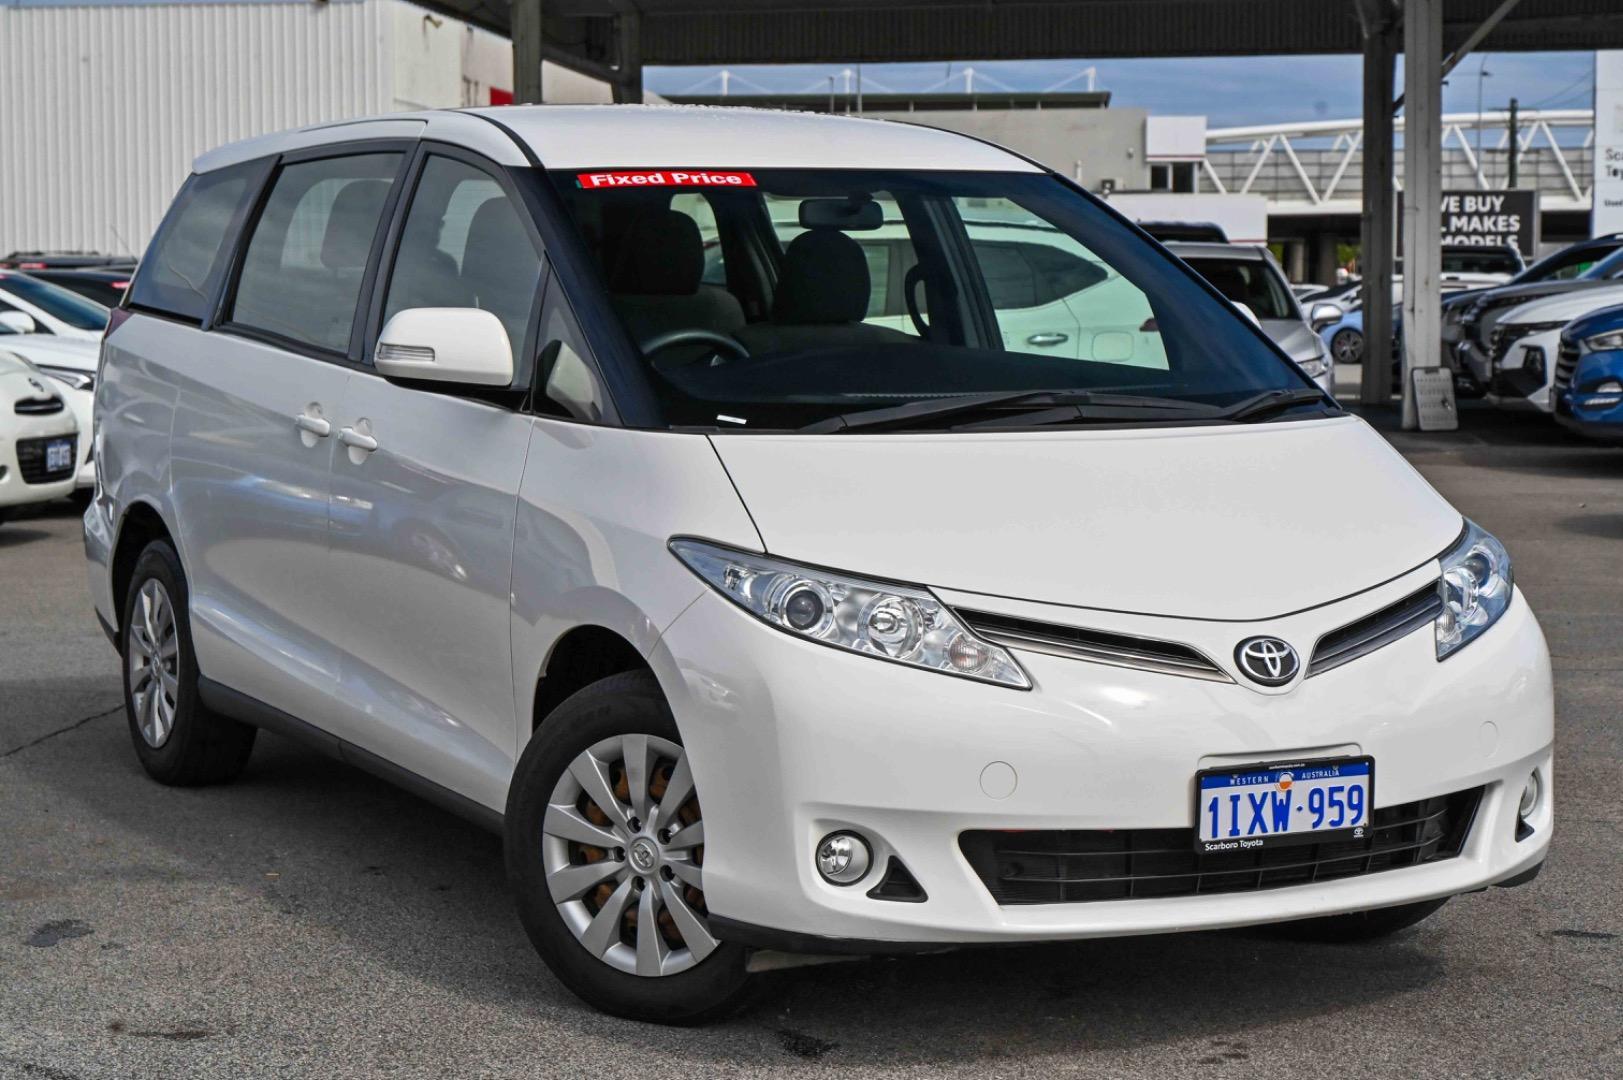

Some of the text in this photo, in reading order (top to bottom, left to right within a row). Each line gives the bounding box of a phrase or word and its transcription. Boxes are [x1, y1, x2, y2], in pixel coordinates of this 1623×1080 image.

[590, 173, 742, 186] Fixed Price
[1464, 195, 1504, 212] BUY
[1450, 215, 1519, 232] MAKES
[1230, 769, 1340, 785] WESTERN AUSTRALIA
[1205, 840, 1264, 851] Scarboro Toyota
